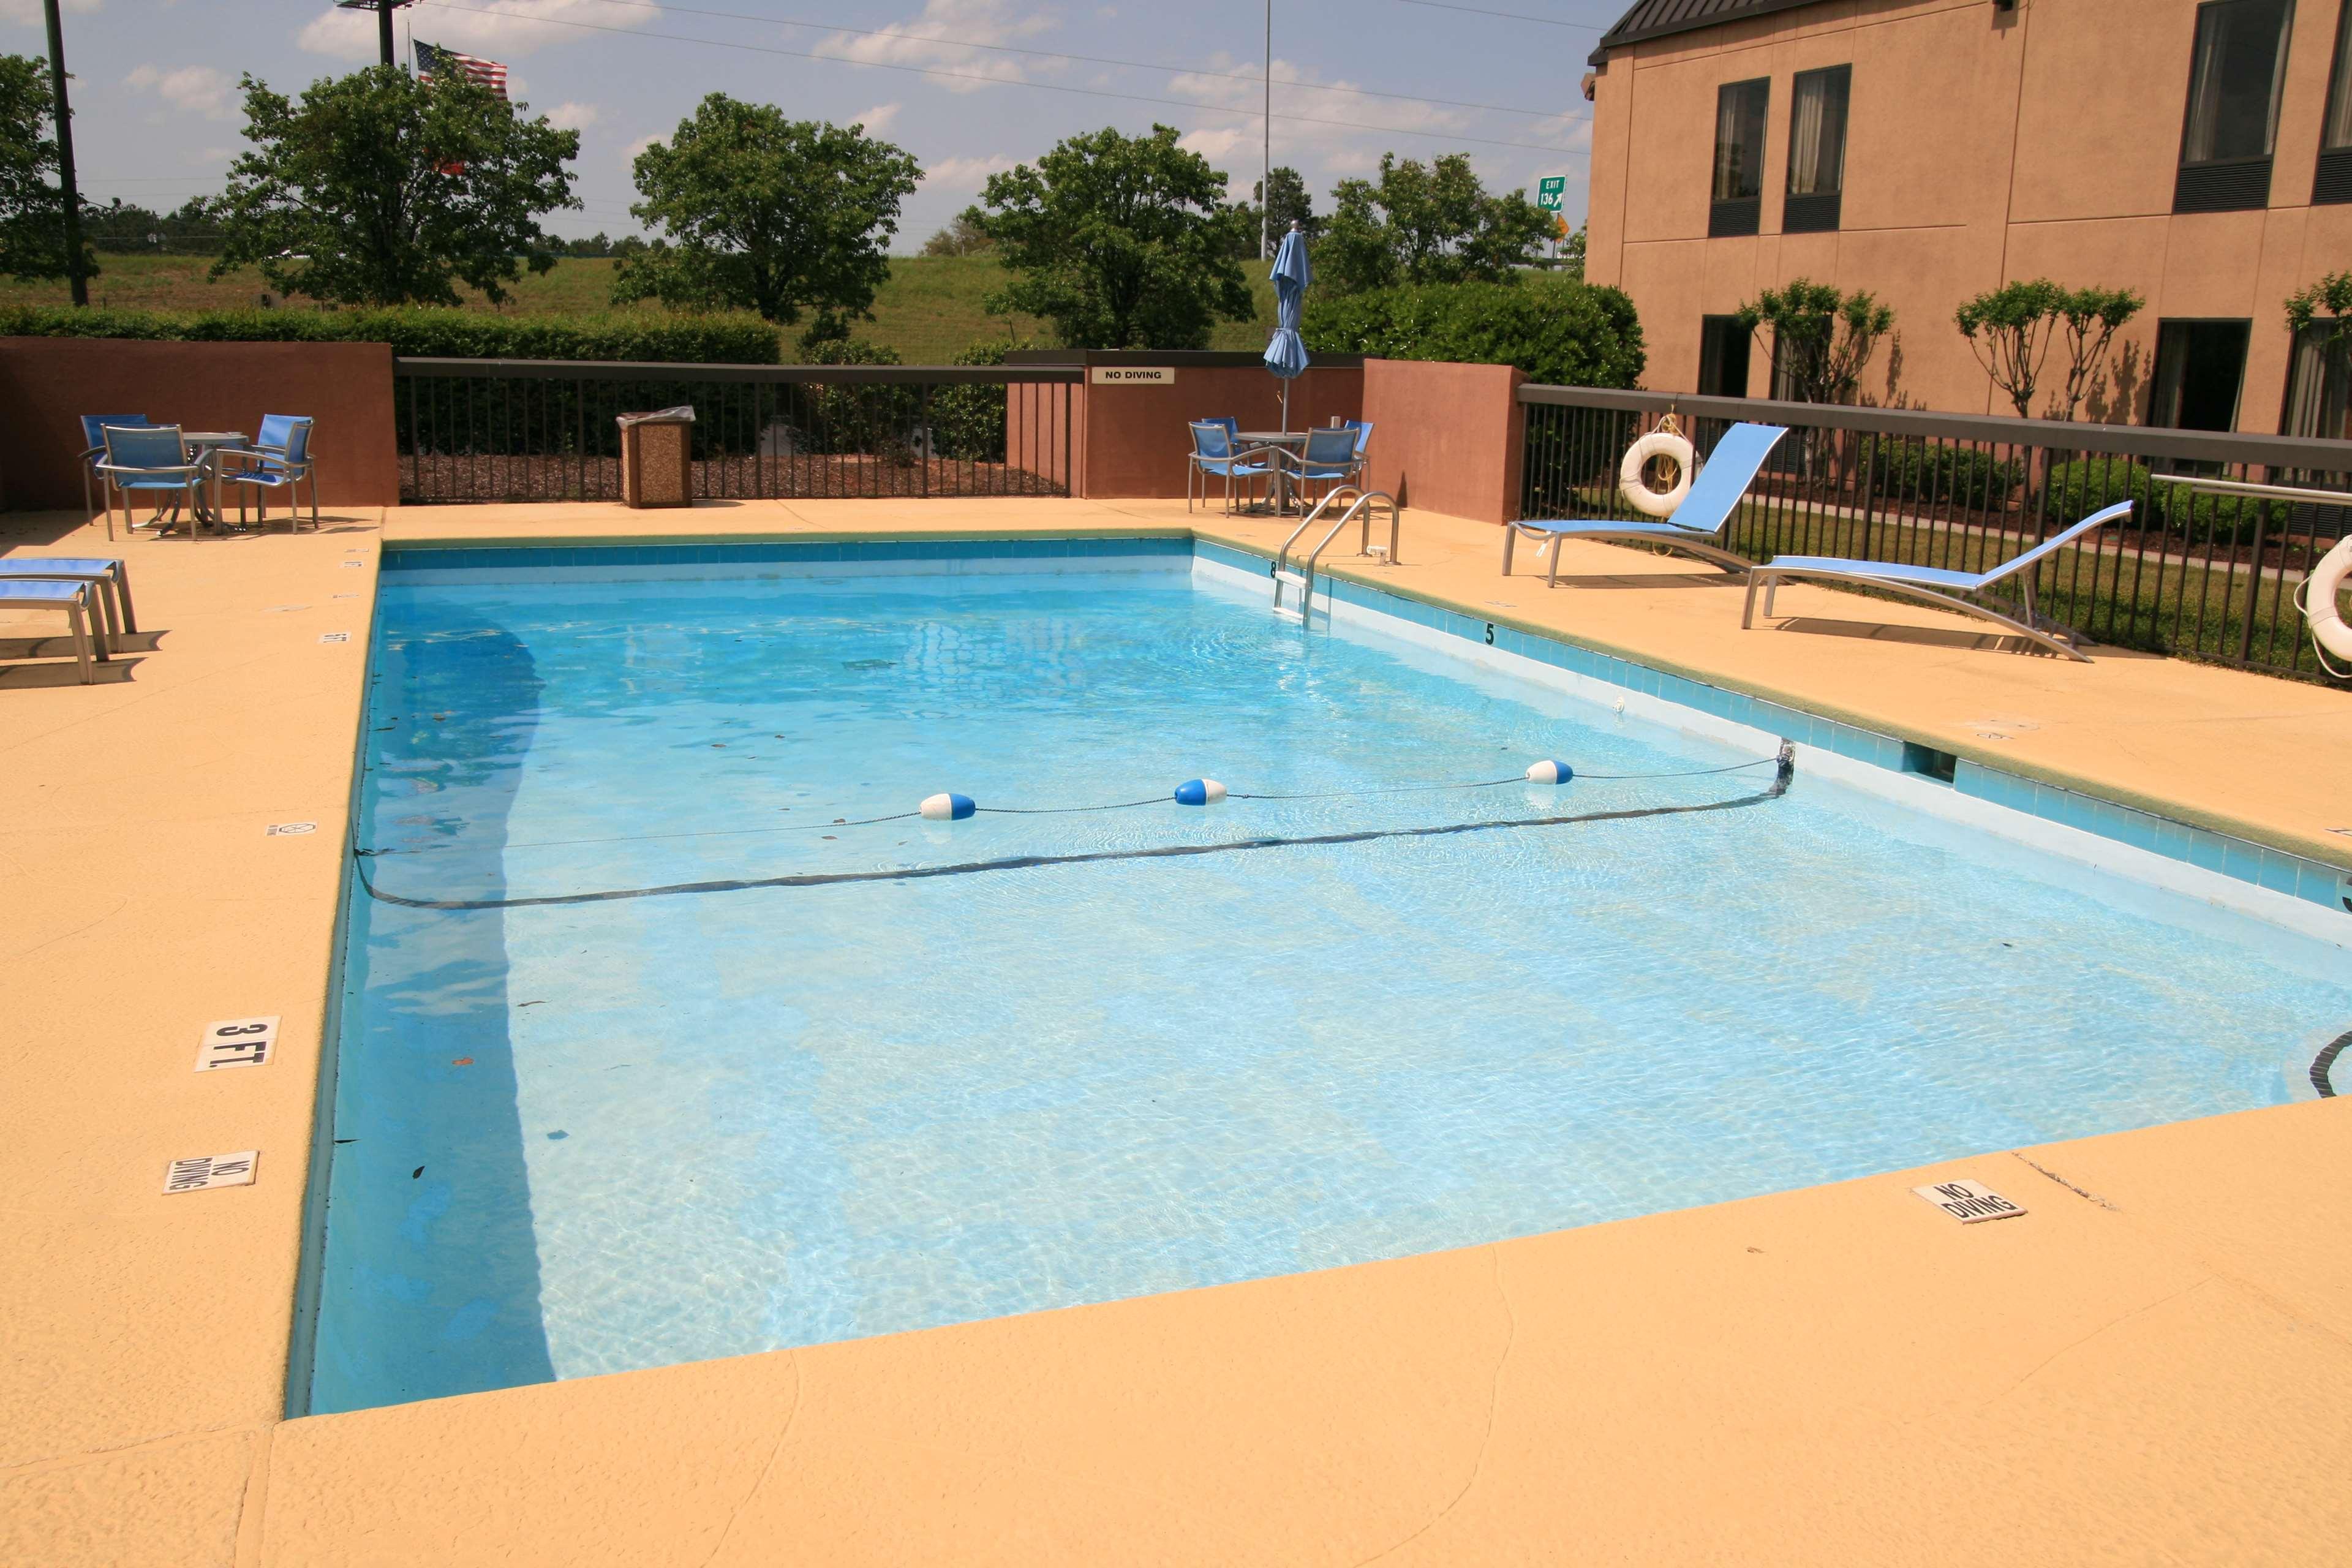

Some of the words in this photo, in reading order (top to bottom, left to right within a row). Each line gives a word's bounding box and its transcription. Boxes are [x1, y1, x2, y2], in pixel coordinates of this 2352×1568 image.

[1546, 180, 1559, 189] EXIT
[1540, 193, 1553, 205] 136
[1270, 561, 1276, 578] 8
[1485, 623, 1494, 645] 5
[216, 1023, 268, 1036] 3
[169, 1157, 213, 1190] DIVING
[211, 1160, 251, 1176] NO
[1933, 1183, 1974, 1200] NO
[1940, 1195, 2018, 1218] DIVING
